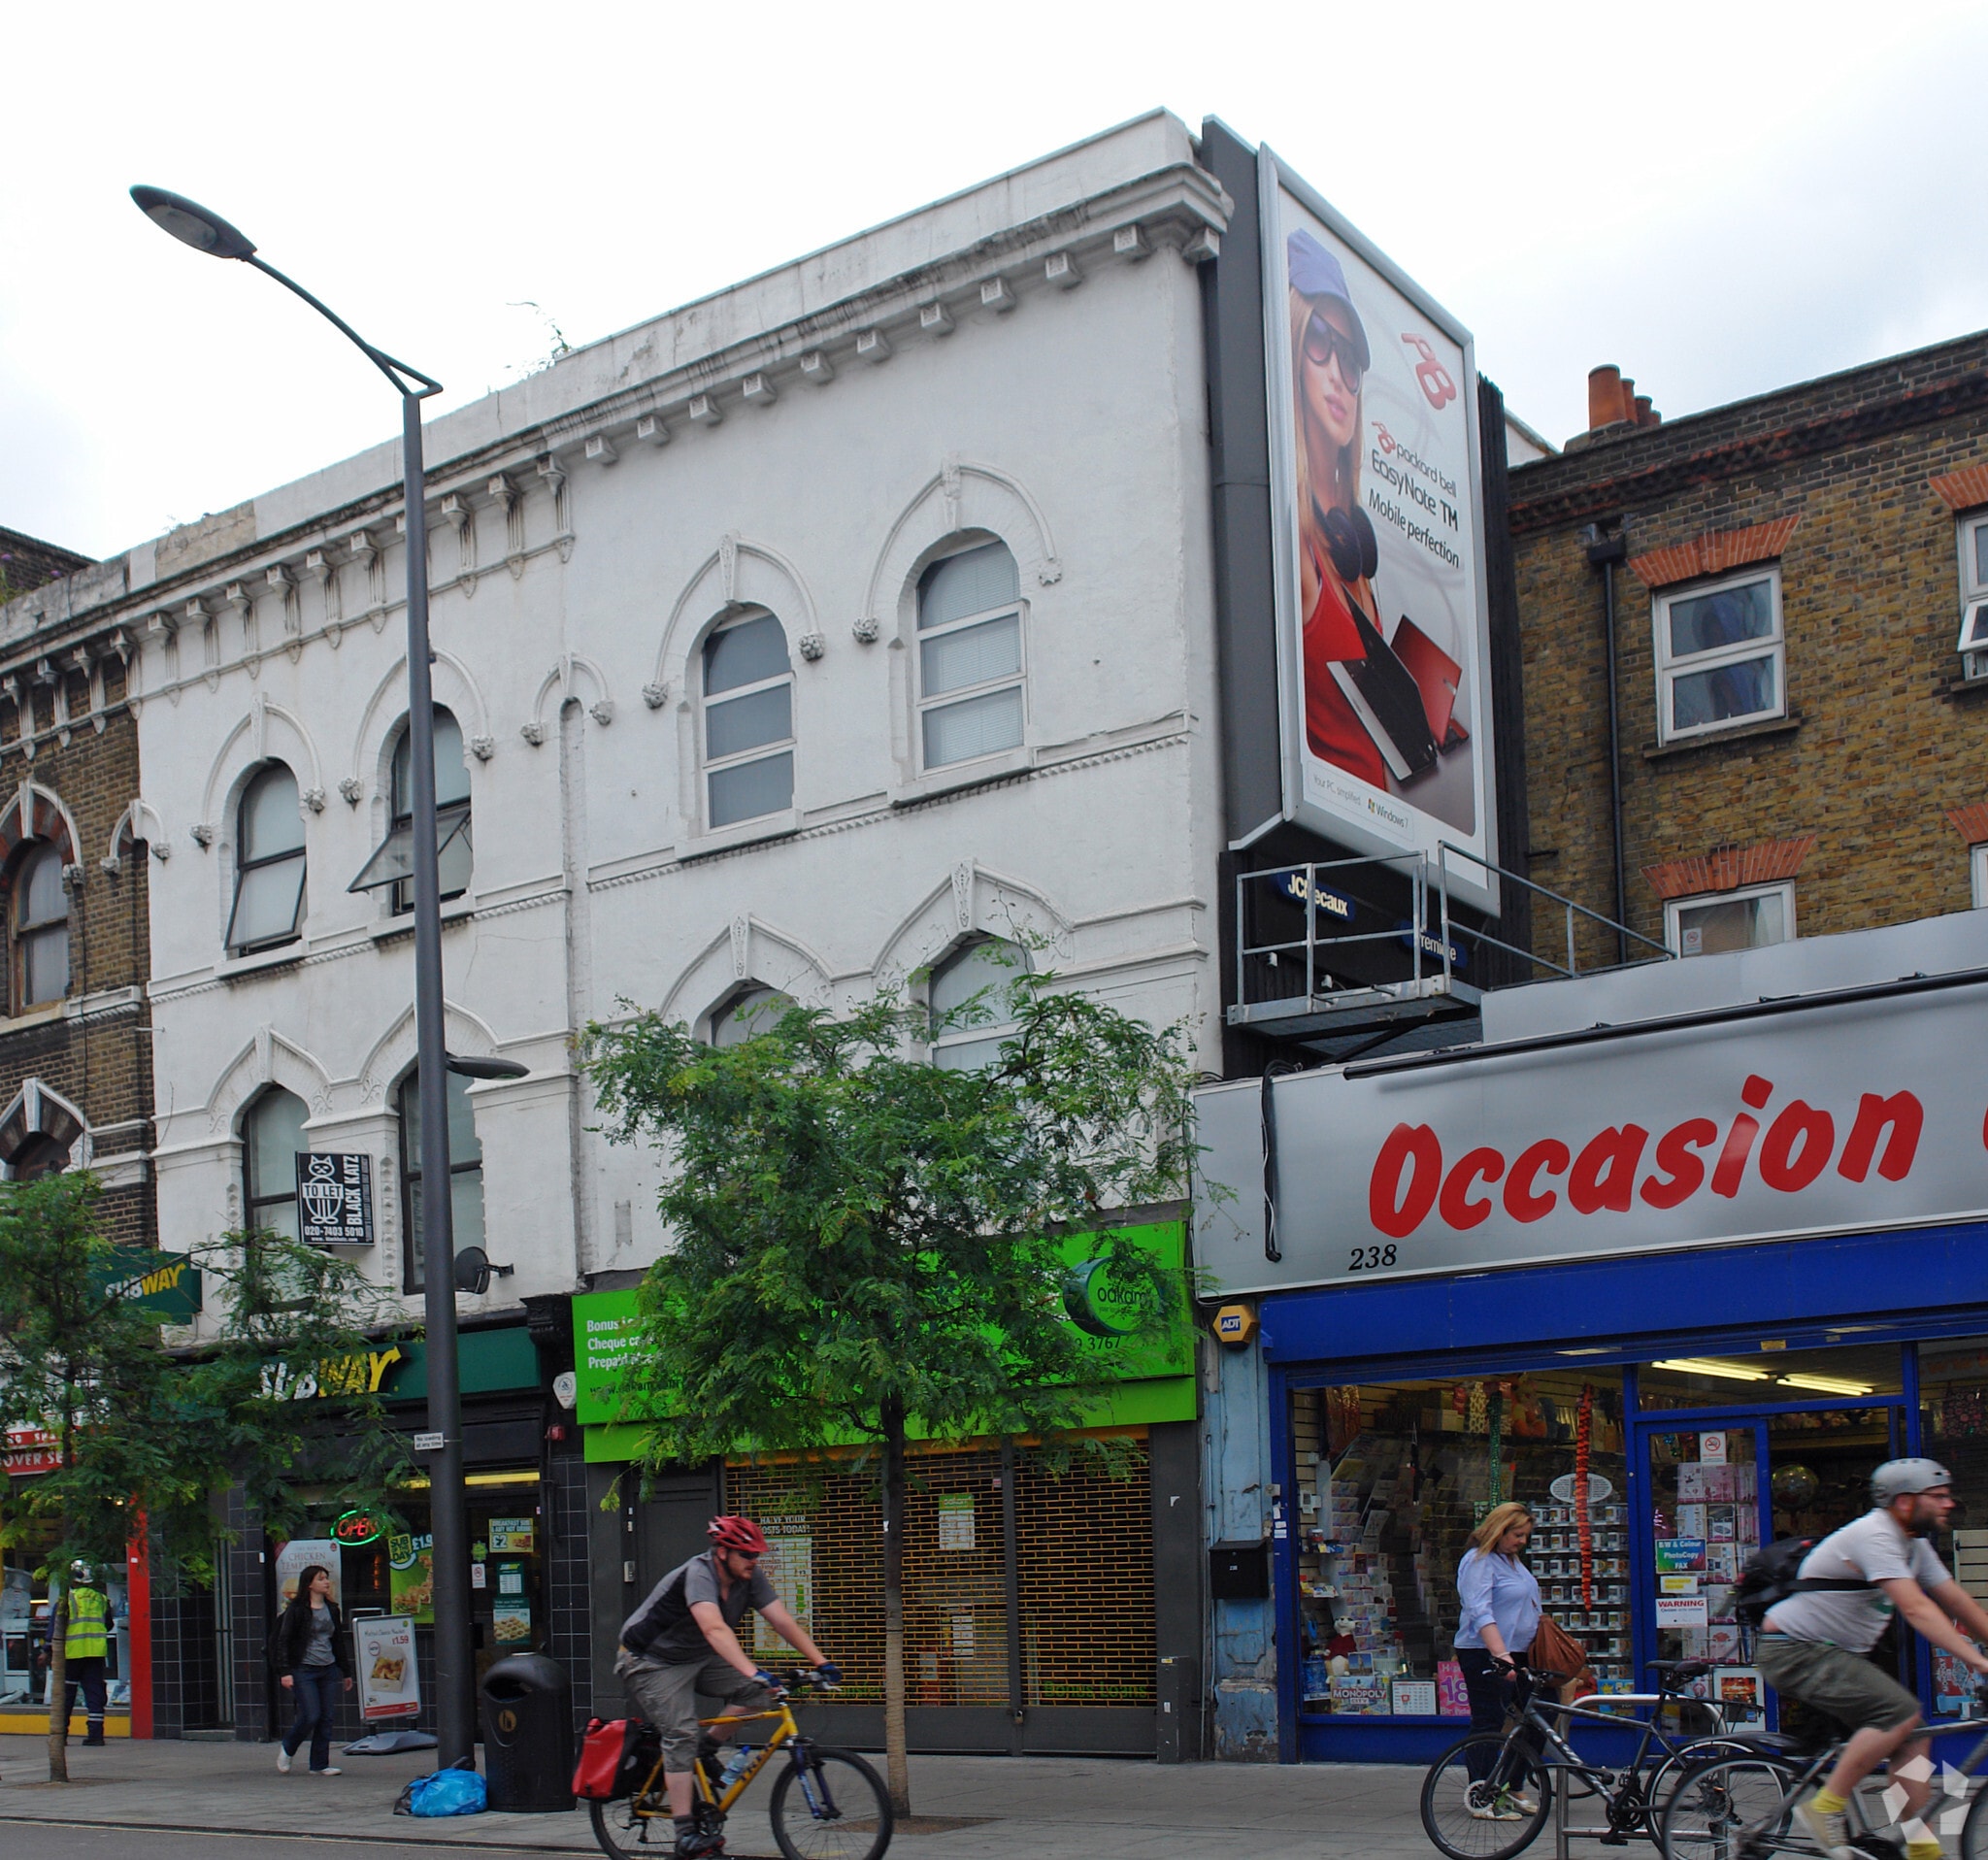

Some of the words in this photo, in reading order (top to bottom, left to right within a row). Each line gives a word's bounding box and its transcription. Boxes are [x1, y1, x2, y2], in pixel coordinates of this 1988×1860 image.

[1397, 443, 1438, 484] packard
[1439, 471, 1457, 498] bell
[1372, 448, 1437, 515] EasyNote
[1440, 498, 1458, 531] TM
[1369, 487, 1407, 531] Mobile
[1407, 520, 1459, 569] perfection
[1375, 803, 1405, 828] Windows
[1288, 874, 1348, 916] JCecaux
[1369, 1074, 1925, 1239] Occasion
[343, 1155, 361, 1184] KATZ
[305, 1185, 318, 1197] TO
[322, 1185, 342, 1197] LET
[345, 1187, 363, 1225] BLACK
[304, 1226, 343, 1236] 020-7403
[345, 1227, 364, 1237] 5010
[1348, 1244, 1398, 1272] 238
[586, 1319, 619, 1333] Bonus
[1222, 1317, 1241, 1330] ADT
[587, 1336, 626, 1352] Cheque
[1088, 1336, 1121, 1350] 3767
[588, 1352, 628, 1371] Prepaid
[337, 1517, 378, 1537] OPEN
[761, 1525, 780, 1535] OSTS
[390, 1536, 409, 1547] SUB
[413, 1534, 433, 1550] £1.9
[492, 1534, 507, 1548] £2
[393, 1551, 412, 1562] DAY
[281, 1561, 335, 1571] TEMPTATION
[1044, 1680, 1095, 1698] Bonus
[1099, 1680, 1148, 1698] Loans
[1333, 1688, 1386, 1699] MONOPOLY
[1441, 1676, 1470, 1706] 18
